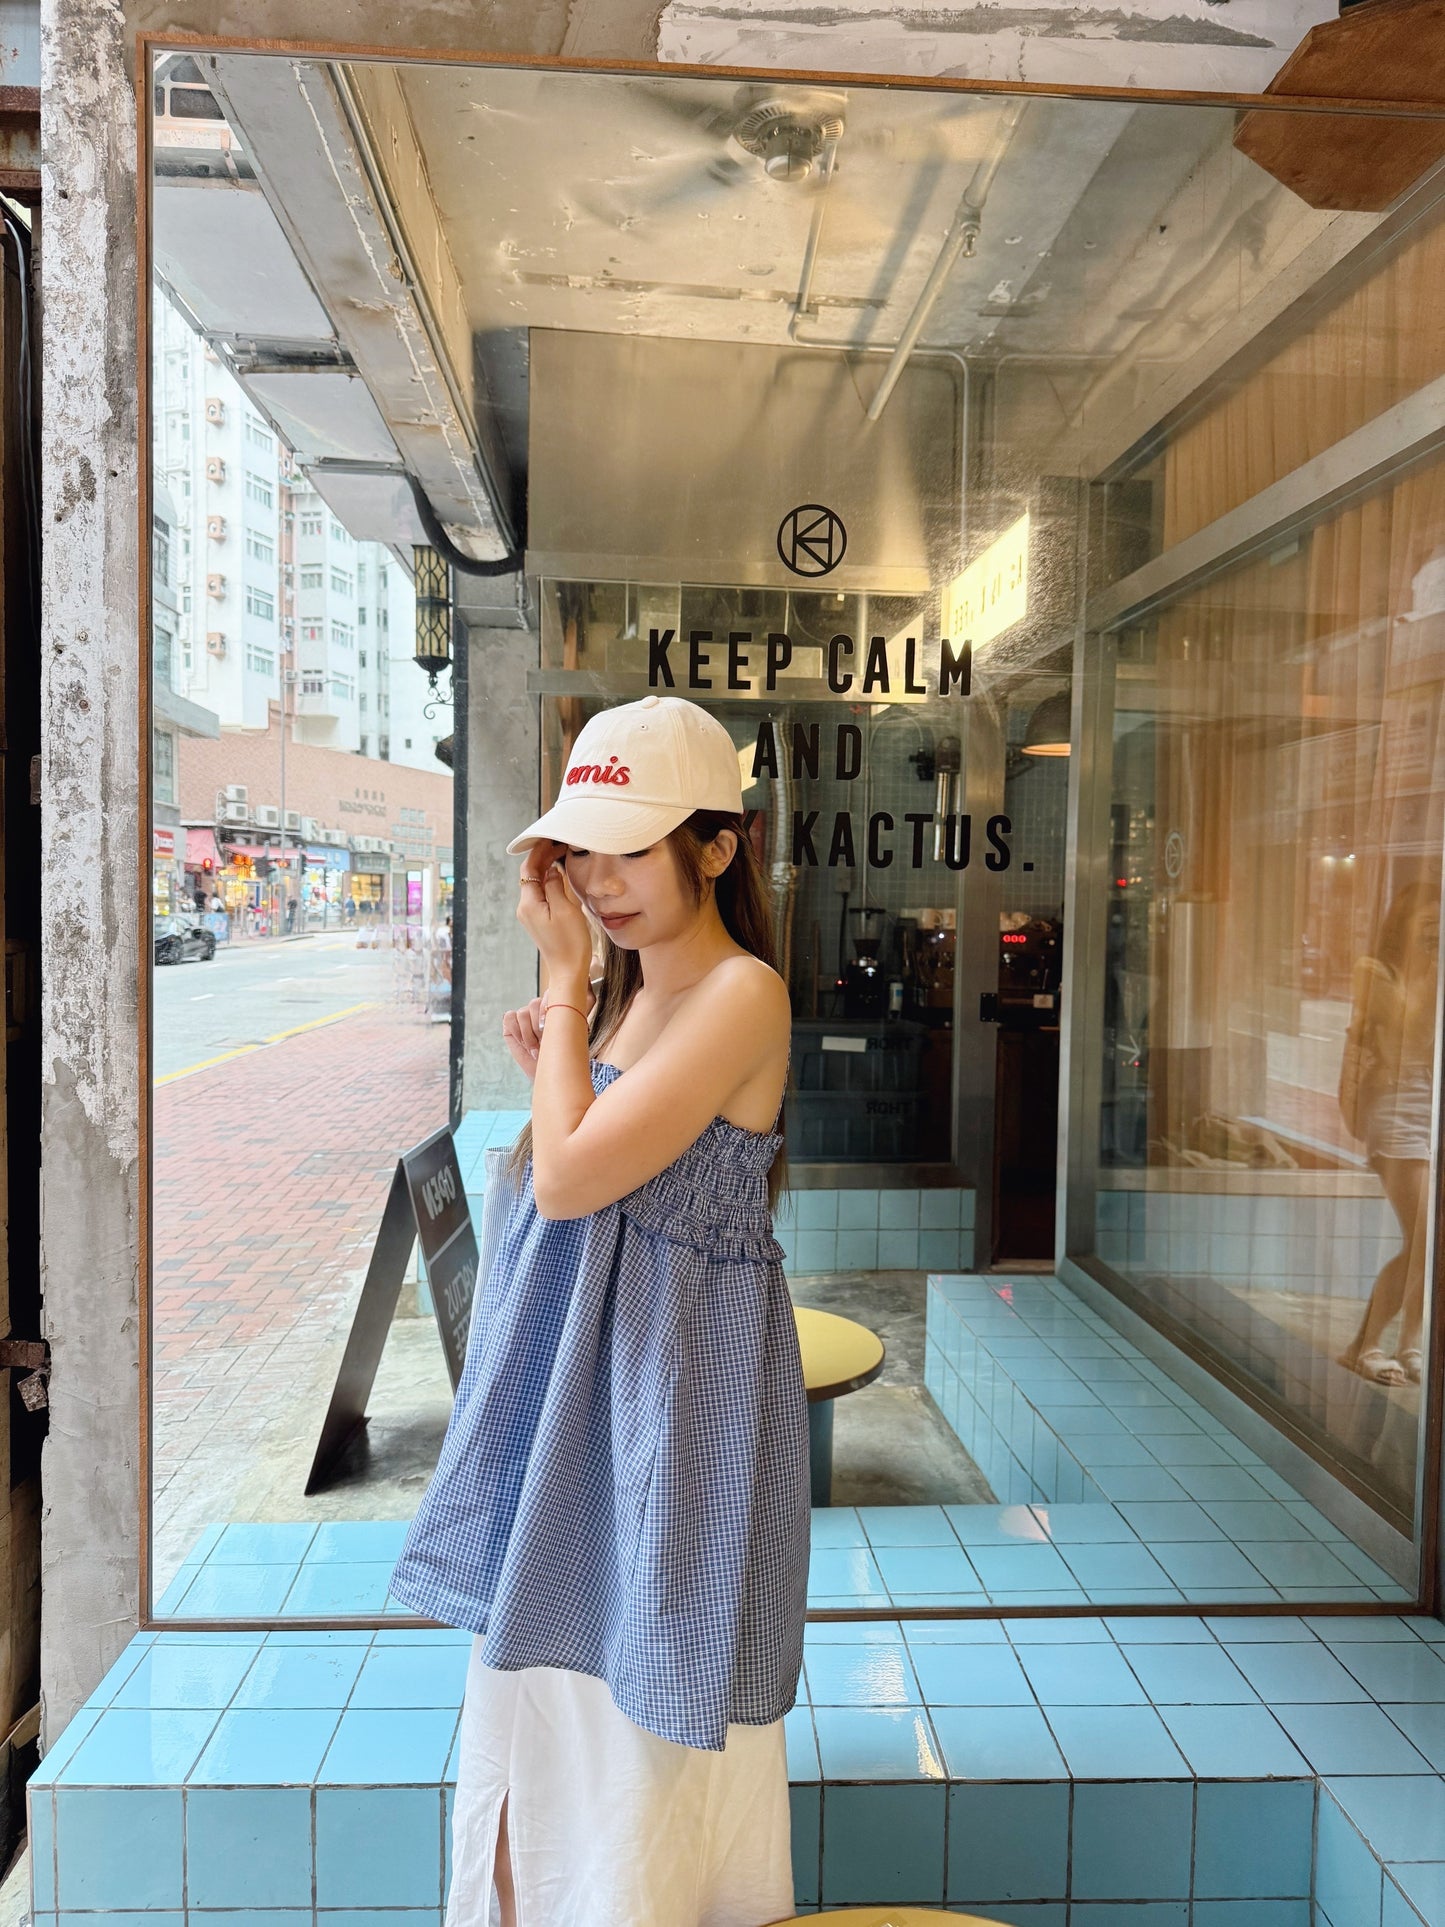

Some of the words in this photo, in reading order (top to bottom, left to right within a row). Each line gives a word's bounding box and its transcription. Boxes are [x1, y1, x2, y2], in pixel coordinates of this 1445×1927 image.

[648, 628, 793, 691] KEEP
[826, 633, 973, 697] CALM
[566, 755, 631, 786] emis
[750, 721, 863, 781] AND
[791, 809, 1035, 872] KACTUS.
